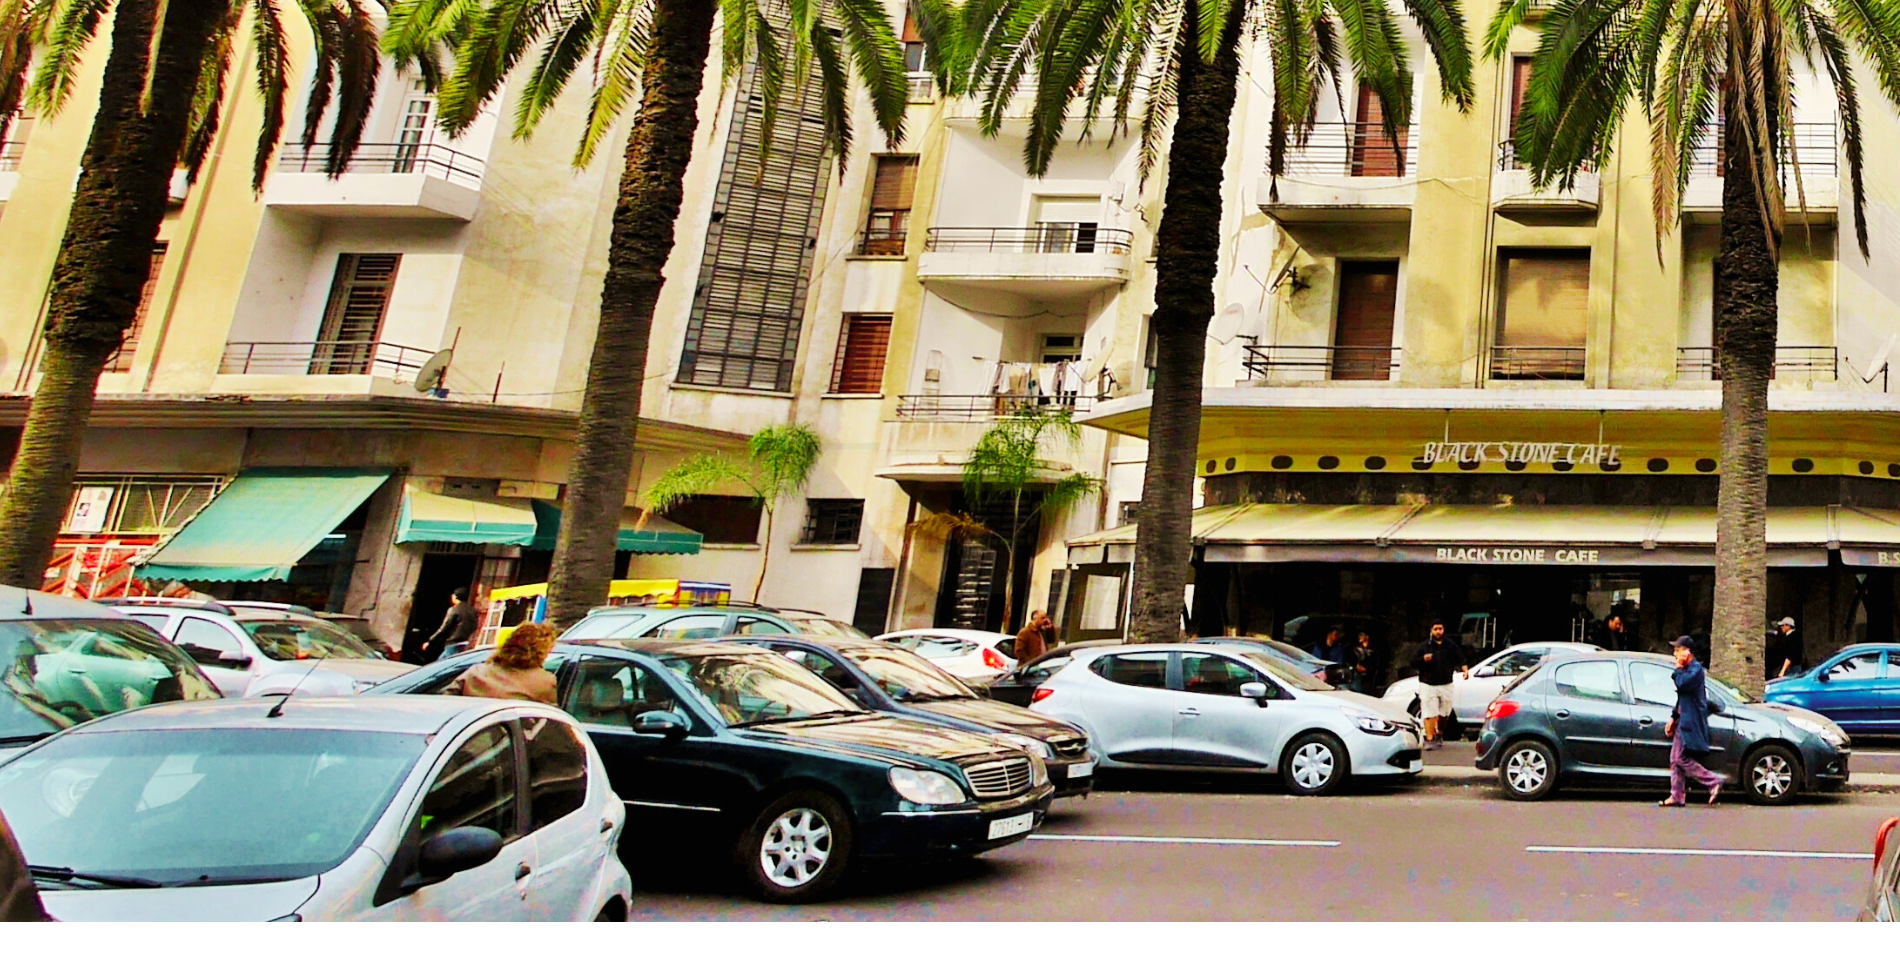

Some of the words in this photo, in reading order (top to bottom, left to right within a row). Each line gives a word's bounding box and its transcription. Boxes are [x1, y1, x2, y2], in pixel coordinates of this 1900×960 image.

[1422, 441, 1490, 464] BLACK
[1493, 441, 1562, 464] STONE
[1565, 443, 1622, 466] CAFE
[1436, 548, 1487, 562] BLACK
[1492, 549, 1545, 563] STONE
[1555, 549, 1599, 563] CAFE
